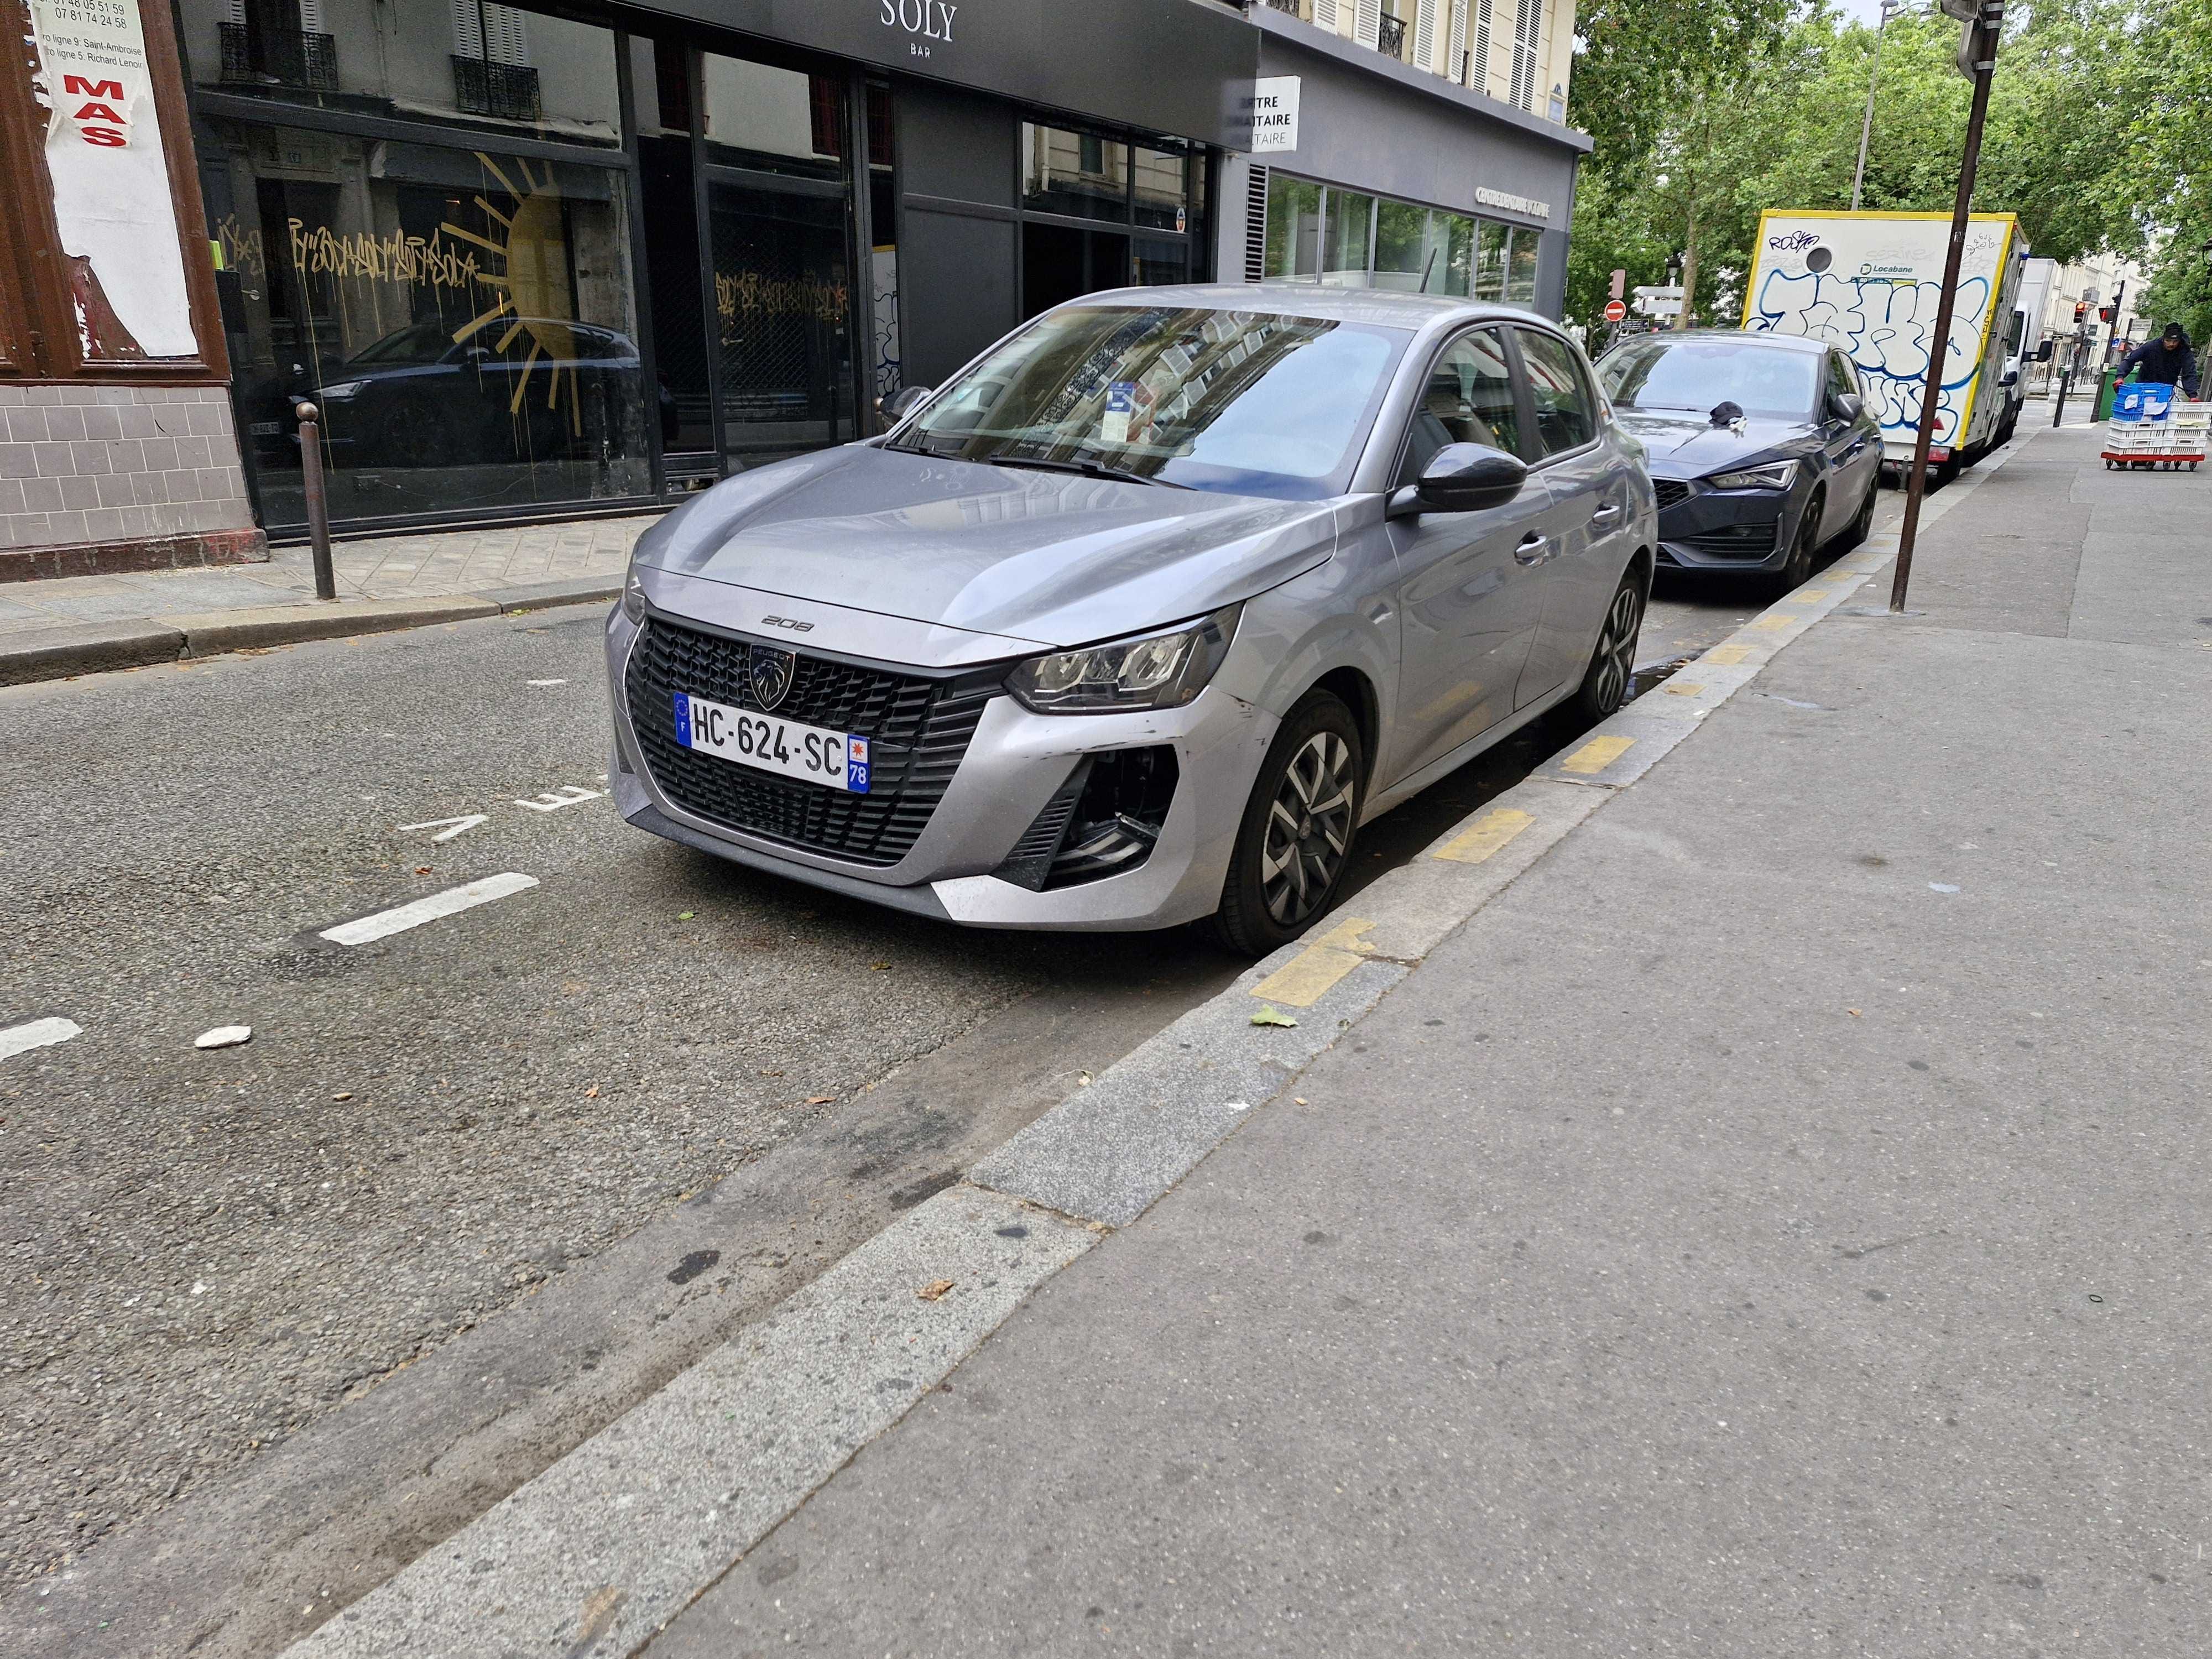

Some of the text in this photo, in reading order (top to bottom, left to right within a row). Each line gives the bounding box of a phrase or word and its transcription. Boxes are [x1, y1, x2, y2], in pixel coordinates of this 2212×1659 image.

[83, 0, 95, 10] 05
[98, 1, 109, 12] 51
[112, 3, 124, 15] 59
[55, 7, 127, 29] 07 81 74 24 58
[880, 0, 958, 42] SOLY
[53, 34, 72, 46] ligne
[73, 37, 82, 46] 9:
[84, 38, 142, 56] Saint-Ambroise
[910, 43, 931, 59] BAR
[57, 48, 76, 60] ligne
[77, 52, 85, 60] 5:
[88, 53, 117, 66] Richard
[119, 59, 143, 69] Lenoir
[63, 74, 128, 147] MAS
[1256, 96, 1279, 108] TRE
[1254, 132, 1286, 145] TAIRE
[1873, 265, 1913, 273] Locabane
[761, 614, 815, 633] 208
[753, 648, 791, 662] PEUGEOT
[680, 703, 867, 785] F HC-624-SC 78
